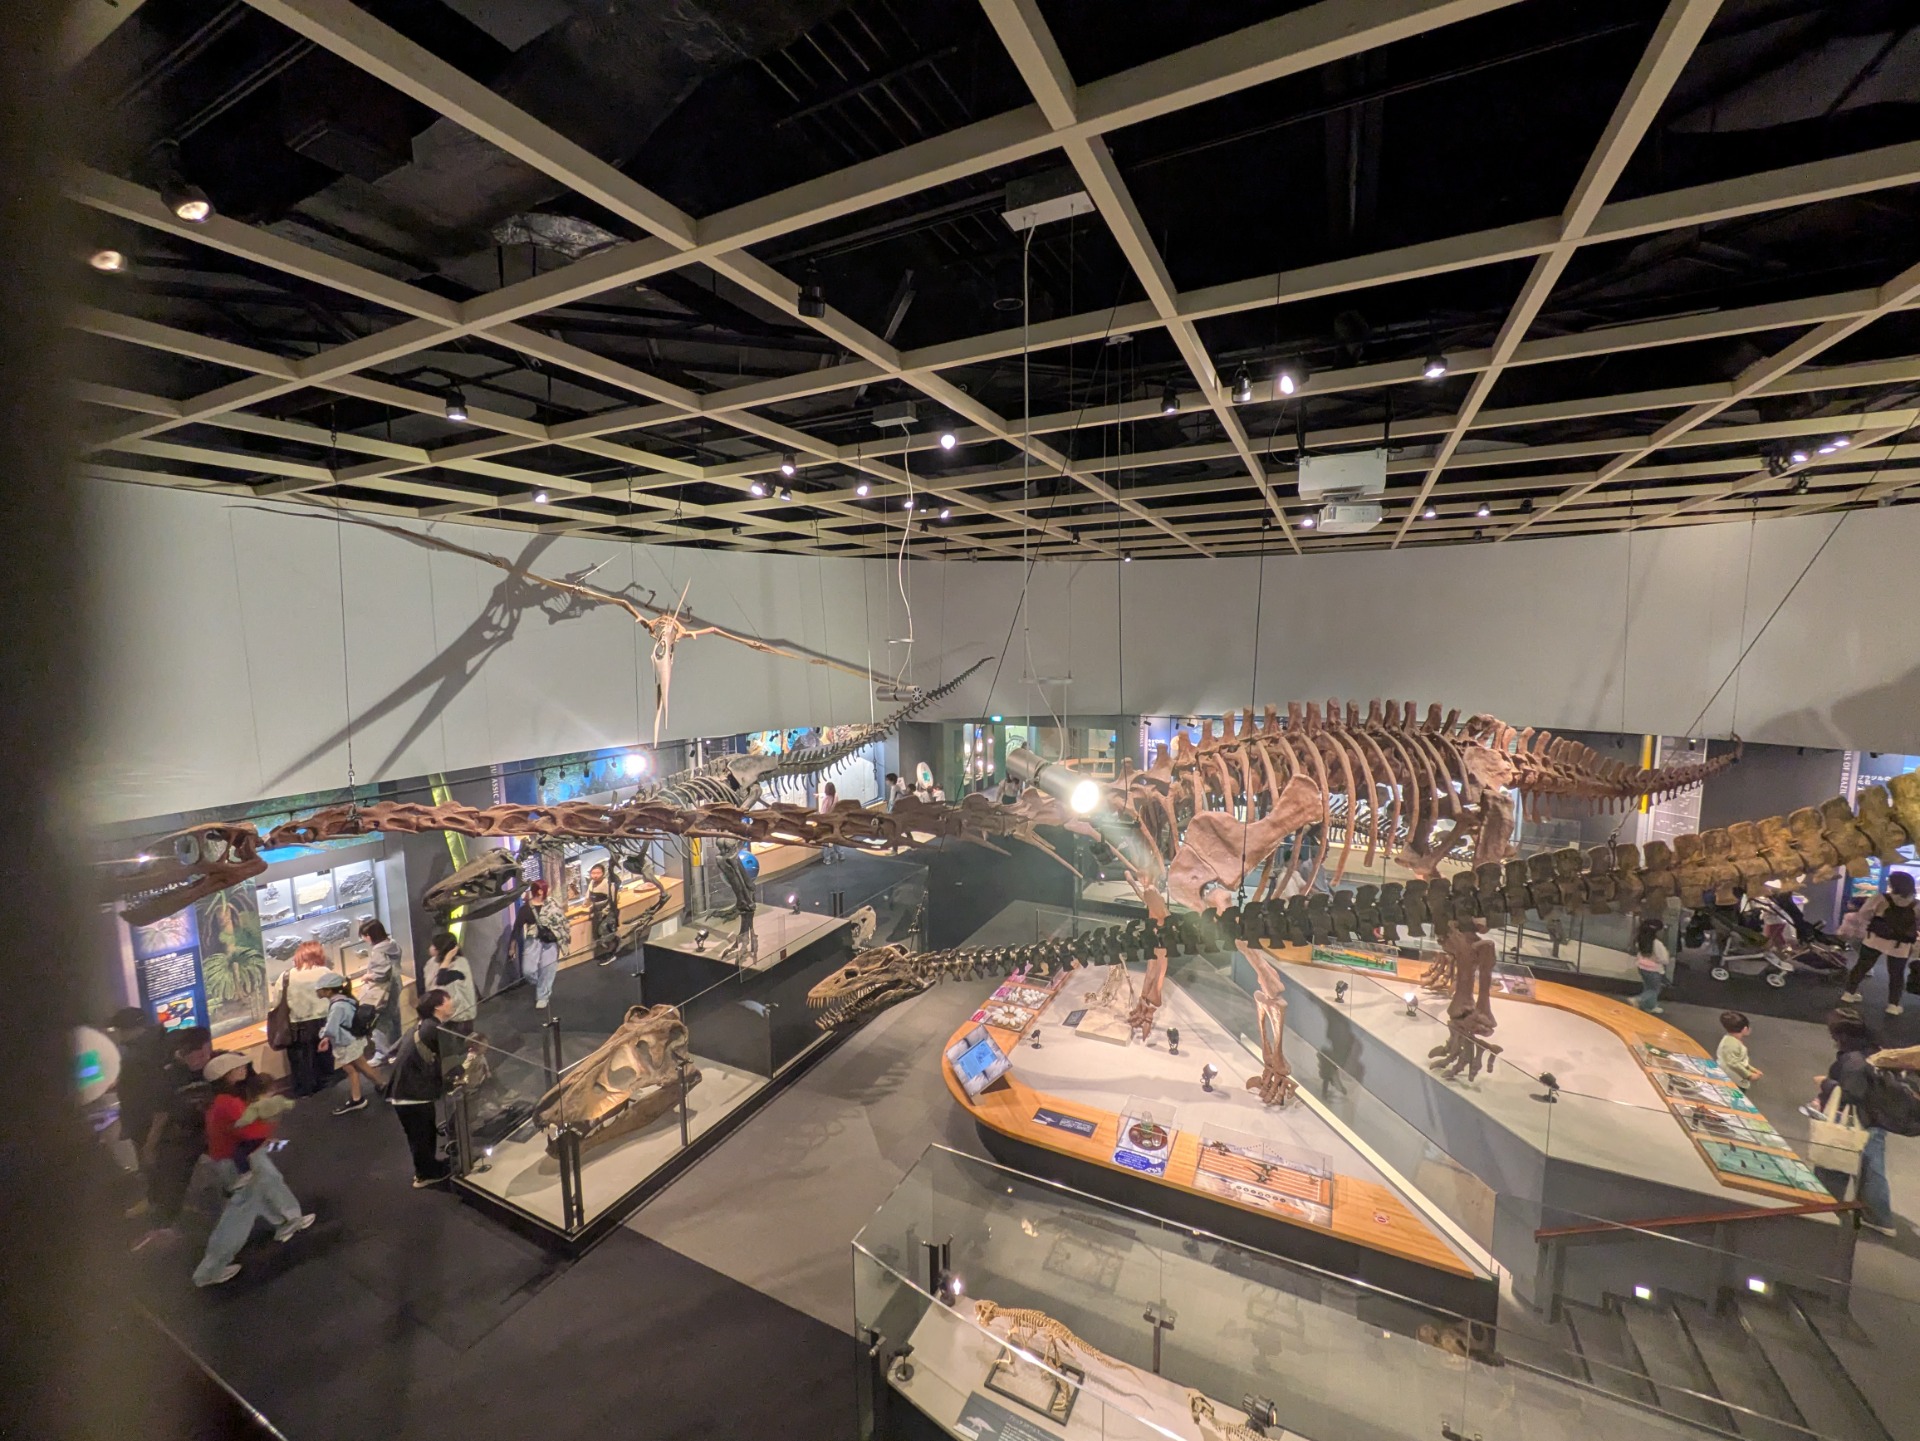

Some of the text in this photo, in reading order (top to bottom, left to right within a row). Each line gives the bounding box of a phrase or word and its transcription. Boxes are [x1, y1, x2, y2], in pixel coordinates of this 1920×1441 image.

[1843, 762, 1851, 770] OF
[490, 766, 500, 798] JUASSIC
[1839, 773, 1849, 794] BRAZIL
